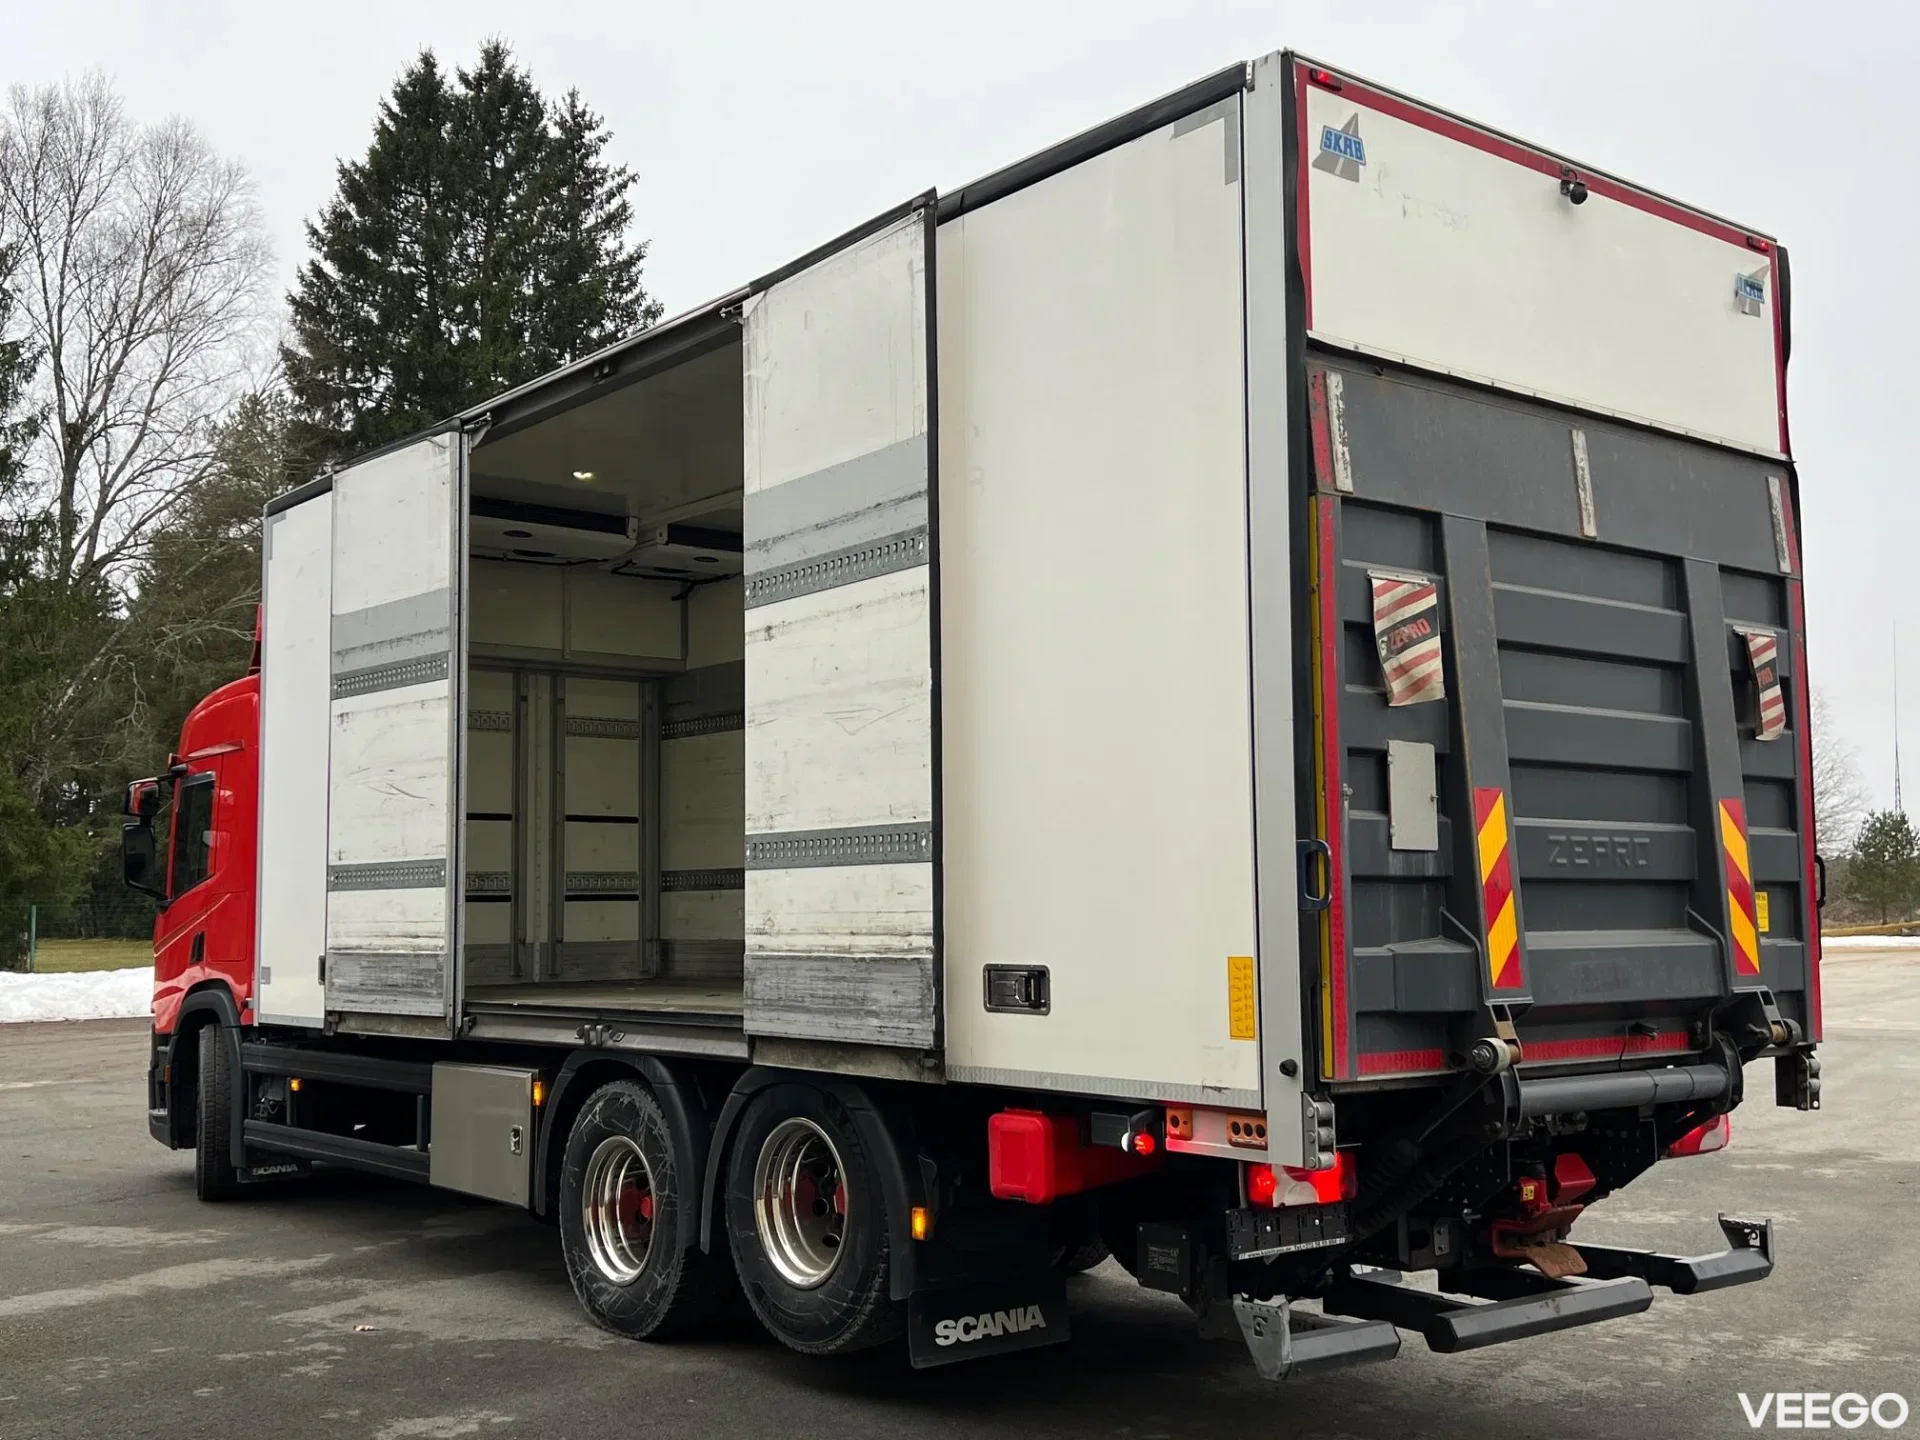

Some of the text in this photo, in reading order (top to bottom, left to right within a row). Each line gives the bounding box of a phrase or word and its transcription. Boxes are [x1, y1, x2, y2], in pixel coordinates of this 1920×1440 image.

[1323, 129, 1364, 161] SKAB
[1548, 835, 1651, 868] ZEPRO
[252, 1164, 298, 1176] SCANIA
[935, 1305, 1046, 1346] SCANIA
